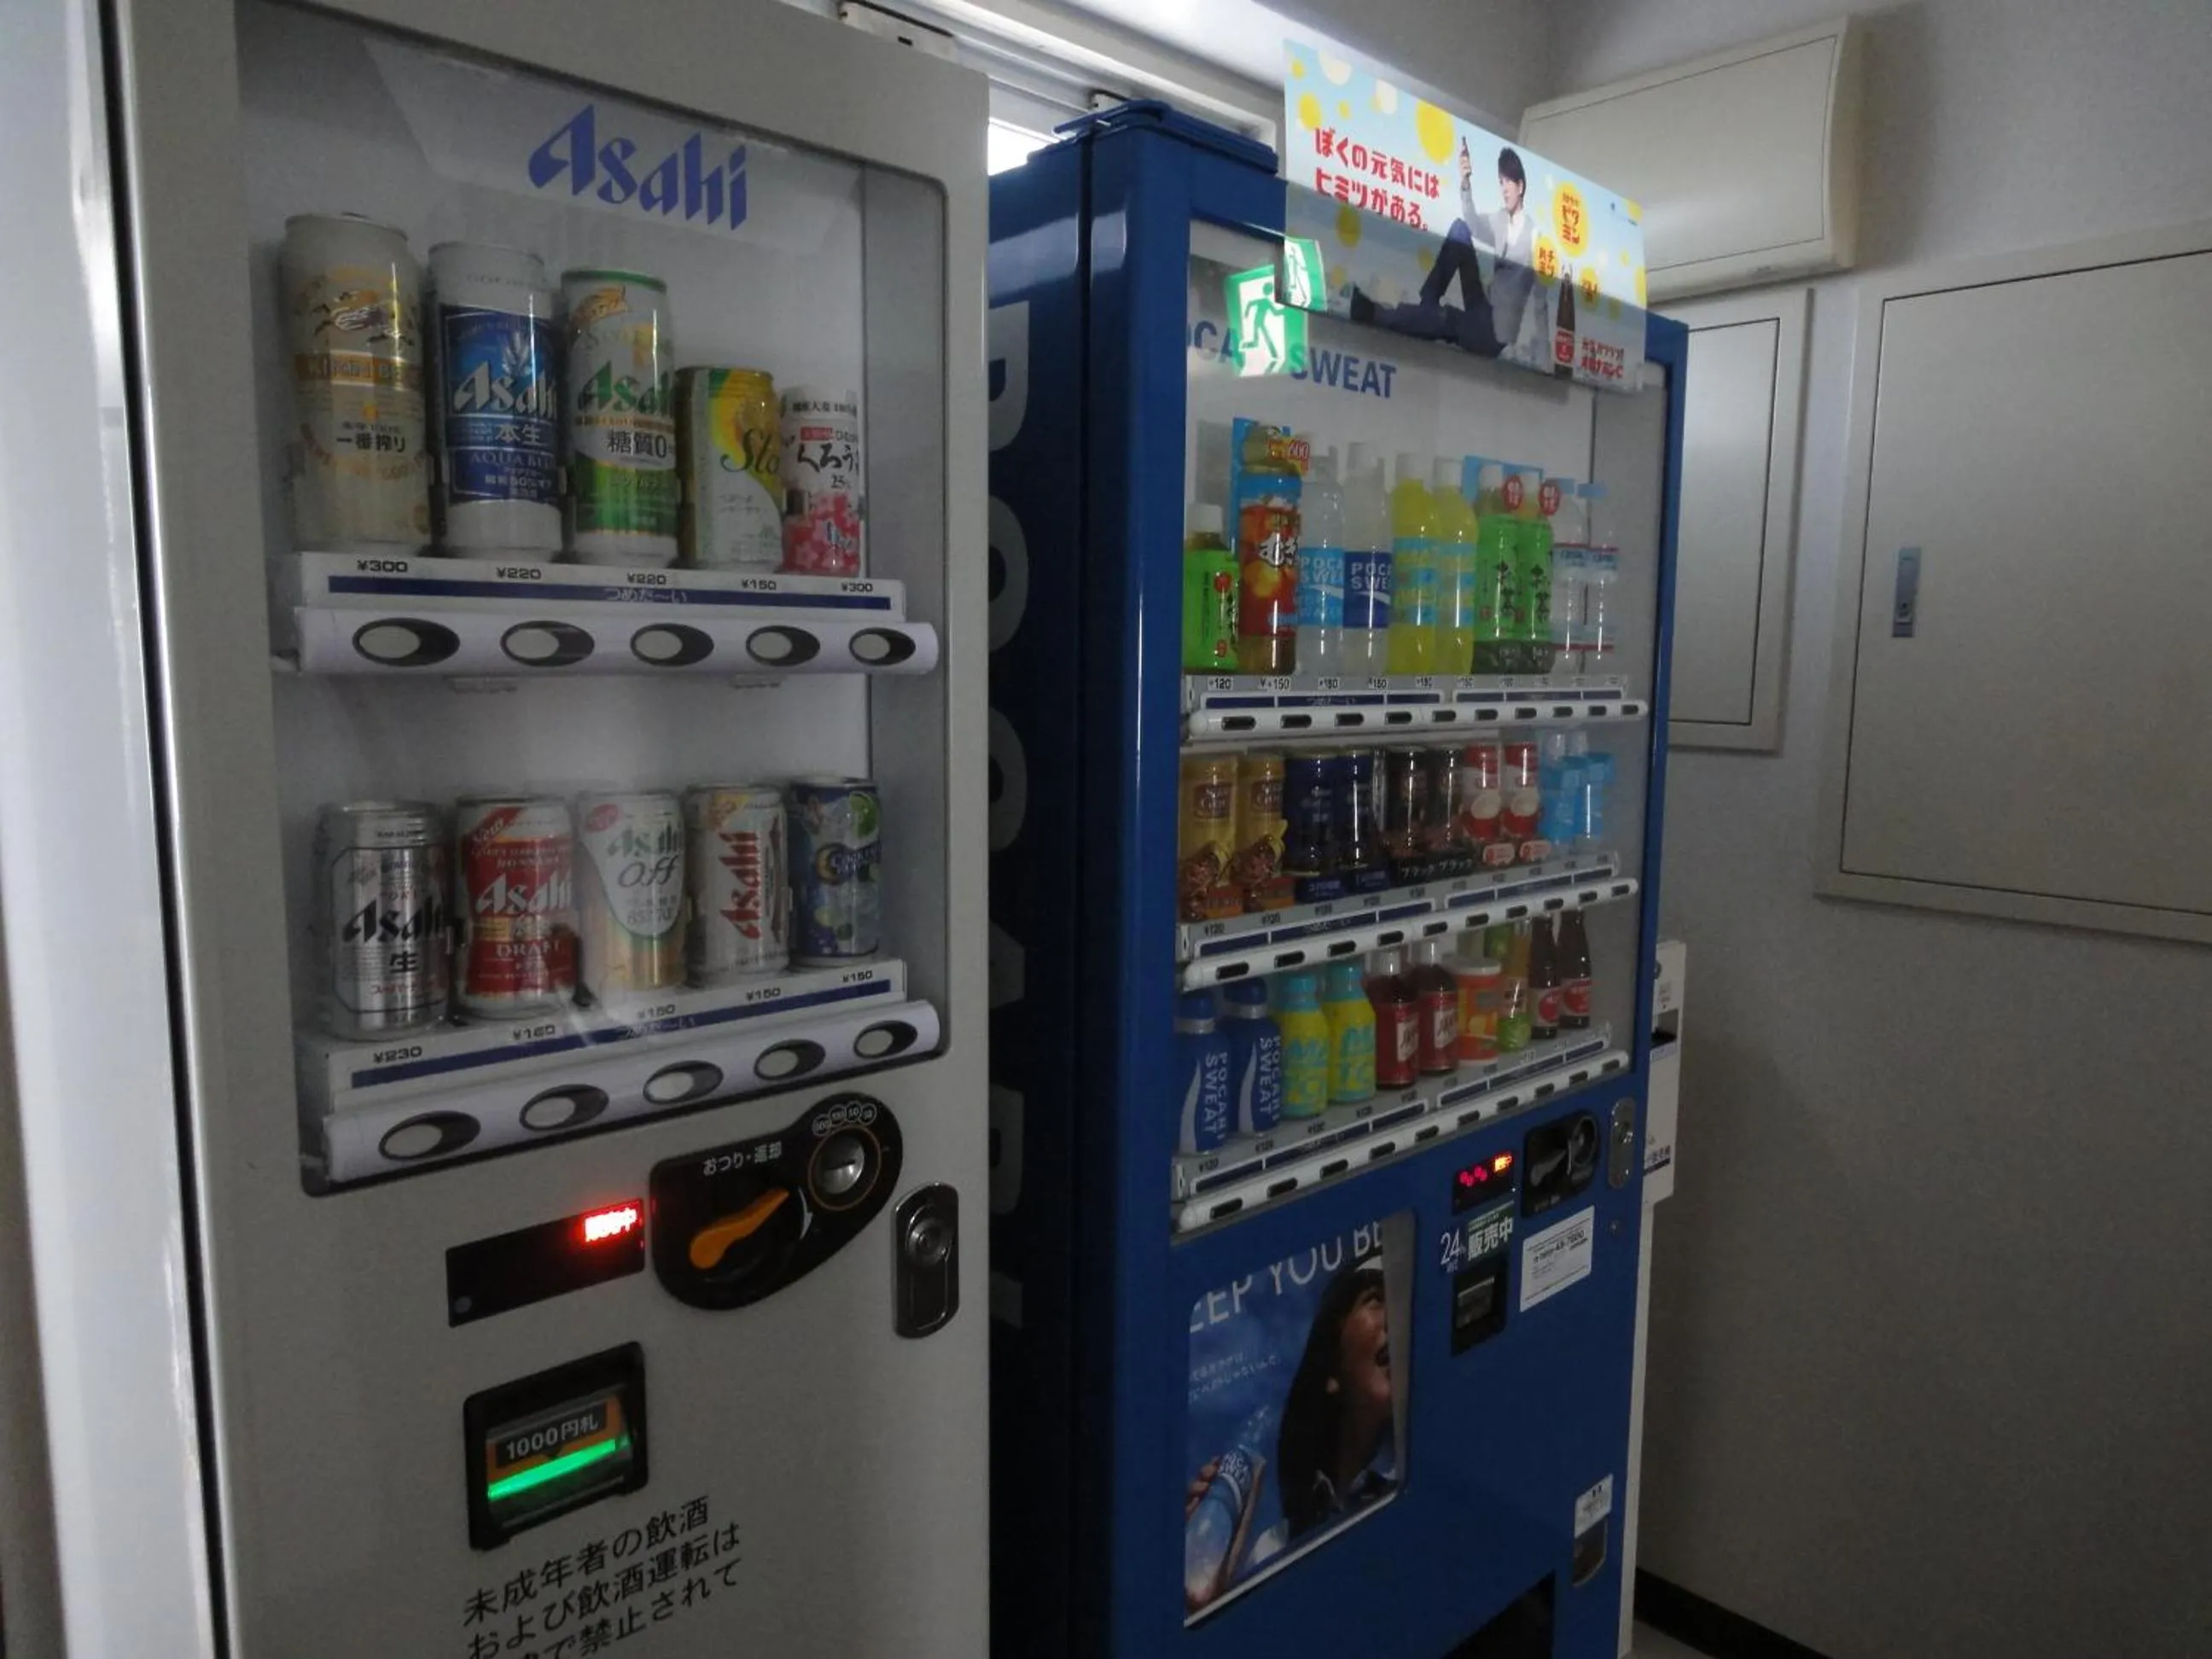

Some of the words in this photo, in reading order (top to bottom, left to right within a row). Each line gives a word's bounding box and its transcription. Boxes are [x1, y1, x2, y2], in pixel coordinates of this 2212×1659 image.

[528, 103, 748, 232] Asahi
[1315, 126, 1441, 199] ぼくの元気には
[1316, 166, 1429, 232] ヒミツがある。
[1290, 343, 1397, 399] SWEAT
[336, 432, 407, 453] 一番搾り
[495, 423, 541, 446] 本生
[357, 559, 409, 574] ¥300
[497, 566, 542, 581] ¥220
[627, 573, 667, 586] ¥220
[388, 950, 421, 975] 生
[746, 987, 782, 1004] ¥150
[373, 1045, 423, 1064] ¥230
[1440, 1228, 1460, 1266] 24
[505, 1412, 599, 1461] 1000円札
[462, 1494, 710, 1627] 未成年者の飲酒
[467, 1521, 741, 1659] および飲酒運転は
